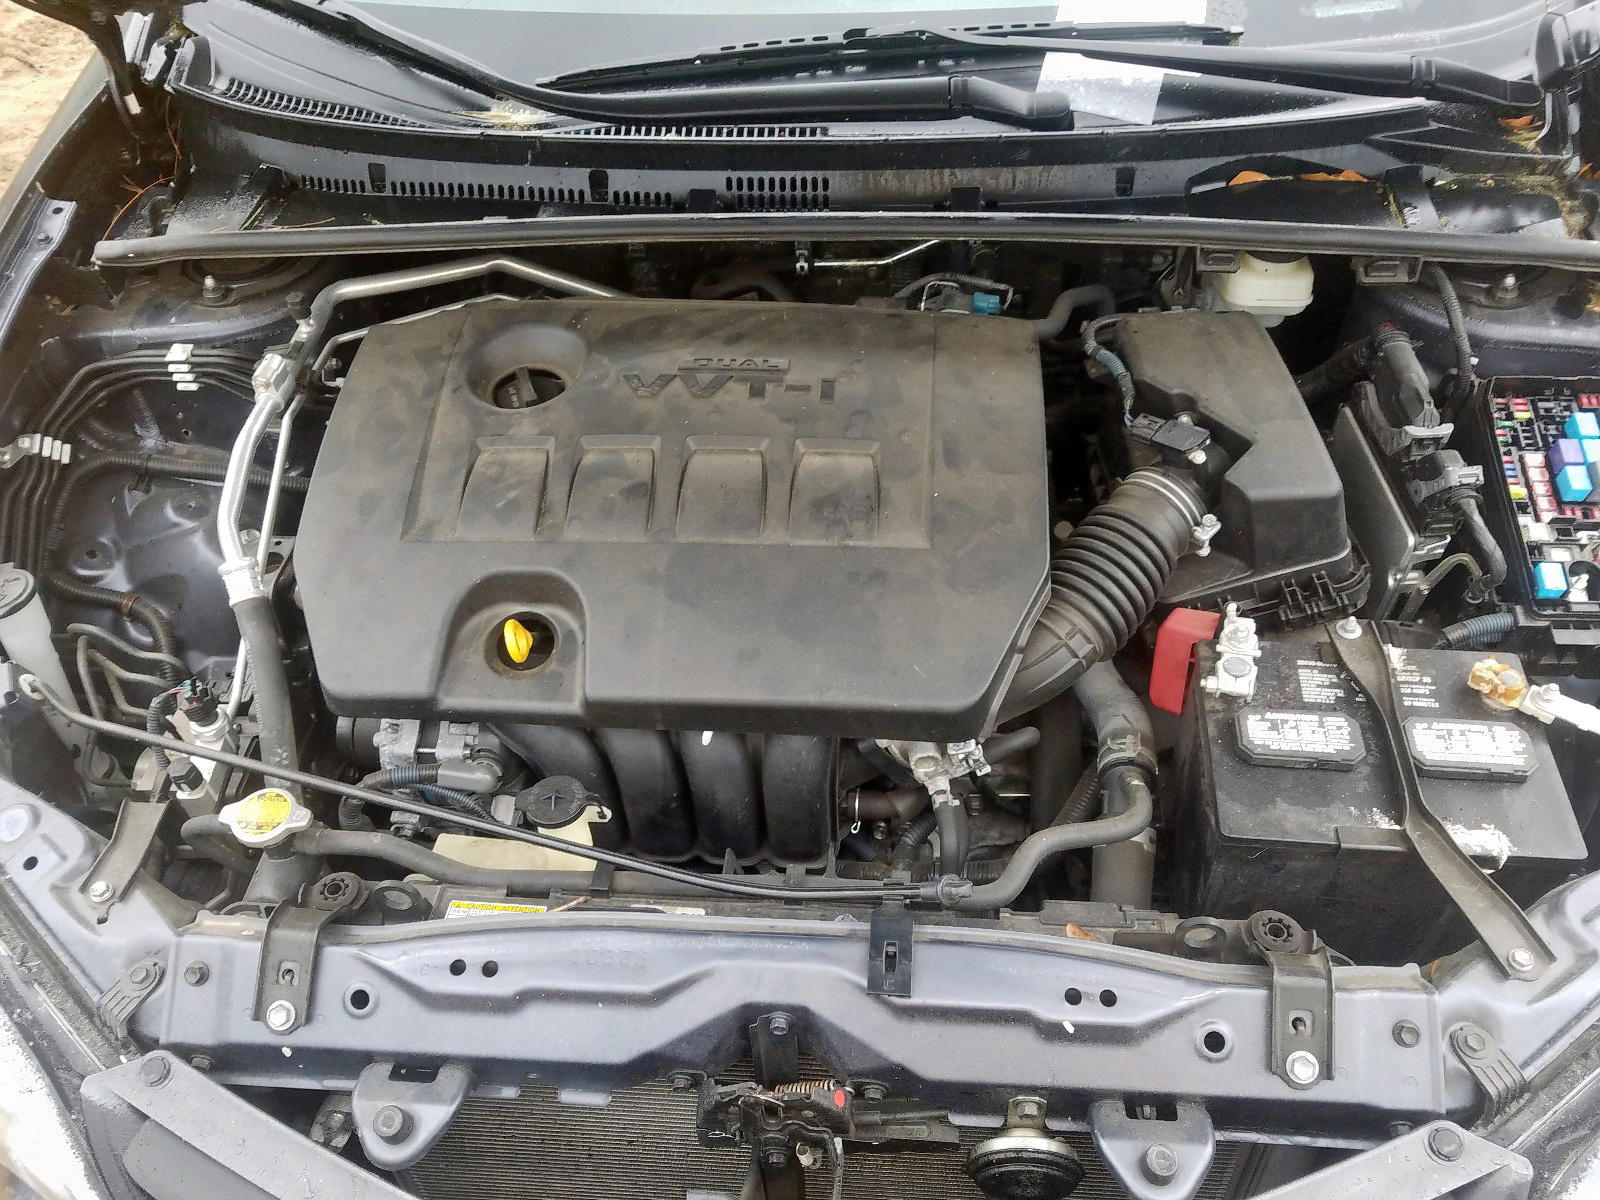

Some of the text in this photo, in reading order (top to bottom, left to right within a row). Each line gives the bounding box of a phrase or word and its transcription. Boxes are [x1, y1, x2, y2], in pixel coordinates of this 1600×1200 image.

[692, 357, 781, 368] DUAL
[466, 903, 542, 913] CAUTION ATTENTION
